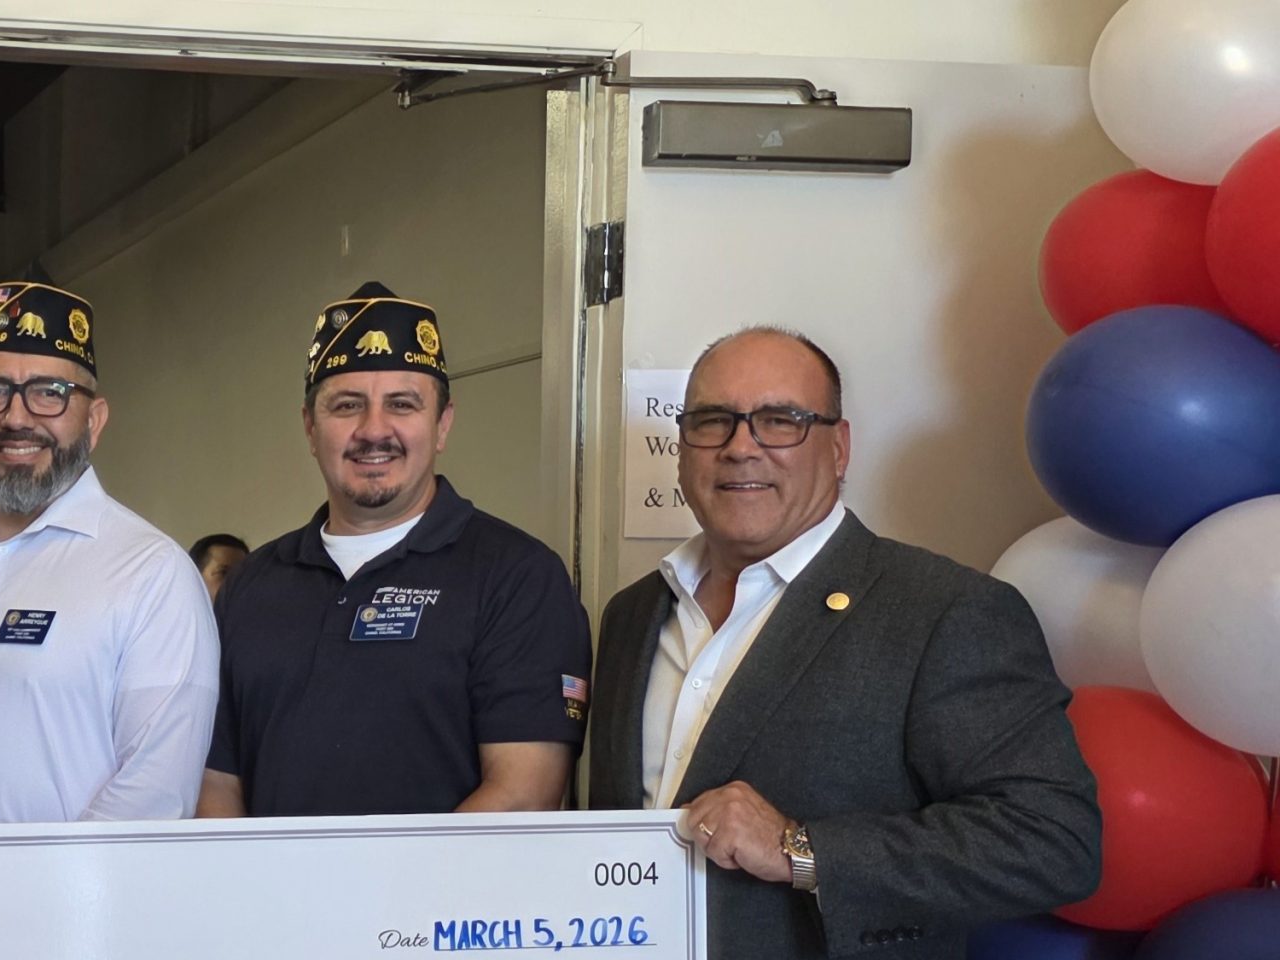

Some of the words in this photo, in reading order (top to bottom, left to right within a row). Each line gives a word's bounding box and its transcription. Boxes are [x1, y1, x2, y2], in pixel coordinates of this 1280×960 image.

[325, 354, 348, 369] 299
[645, 397, 684, 417] Res
[645, 436, 680, 457] Wo
[644, 487, 664, 508] &
[371, 593, 438, 605] LEGION
[392, 587, 440, 596] AMERICAN
[594, 862, 658, 886] 0004
[378, 929, 430, 949] Date
[433, 919, 522, 951] MARCH
